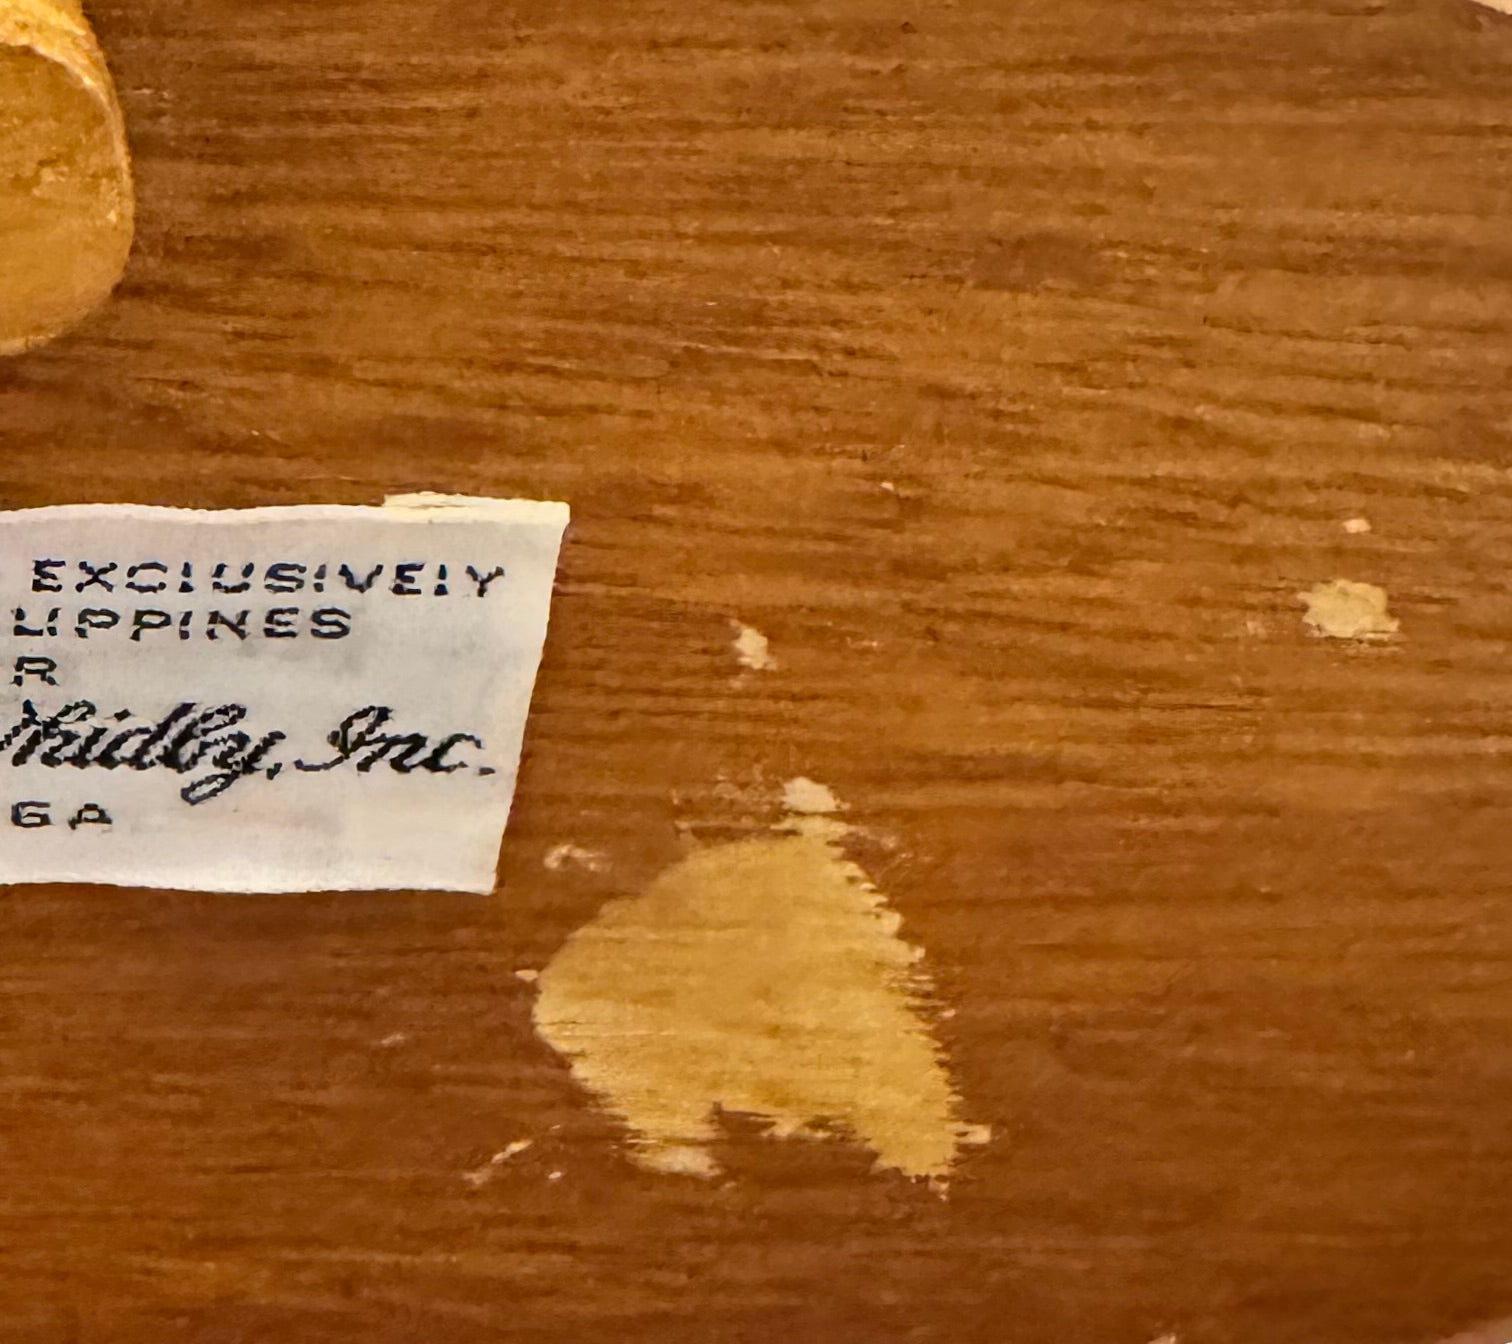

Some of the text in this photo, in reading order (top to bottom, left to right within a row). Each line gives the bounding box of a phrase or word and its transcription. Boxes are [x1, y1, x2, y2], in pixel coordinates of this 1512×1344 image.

[31, 557, 505, 597] EXCLUSIVELY
[293, 705, 496, 774] Inc.
[10, 800, 113, 830] GA
